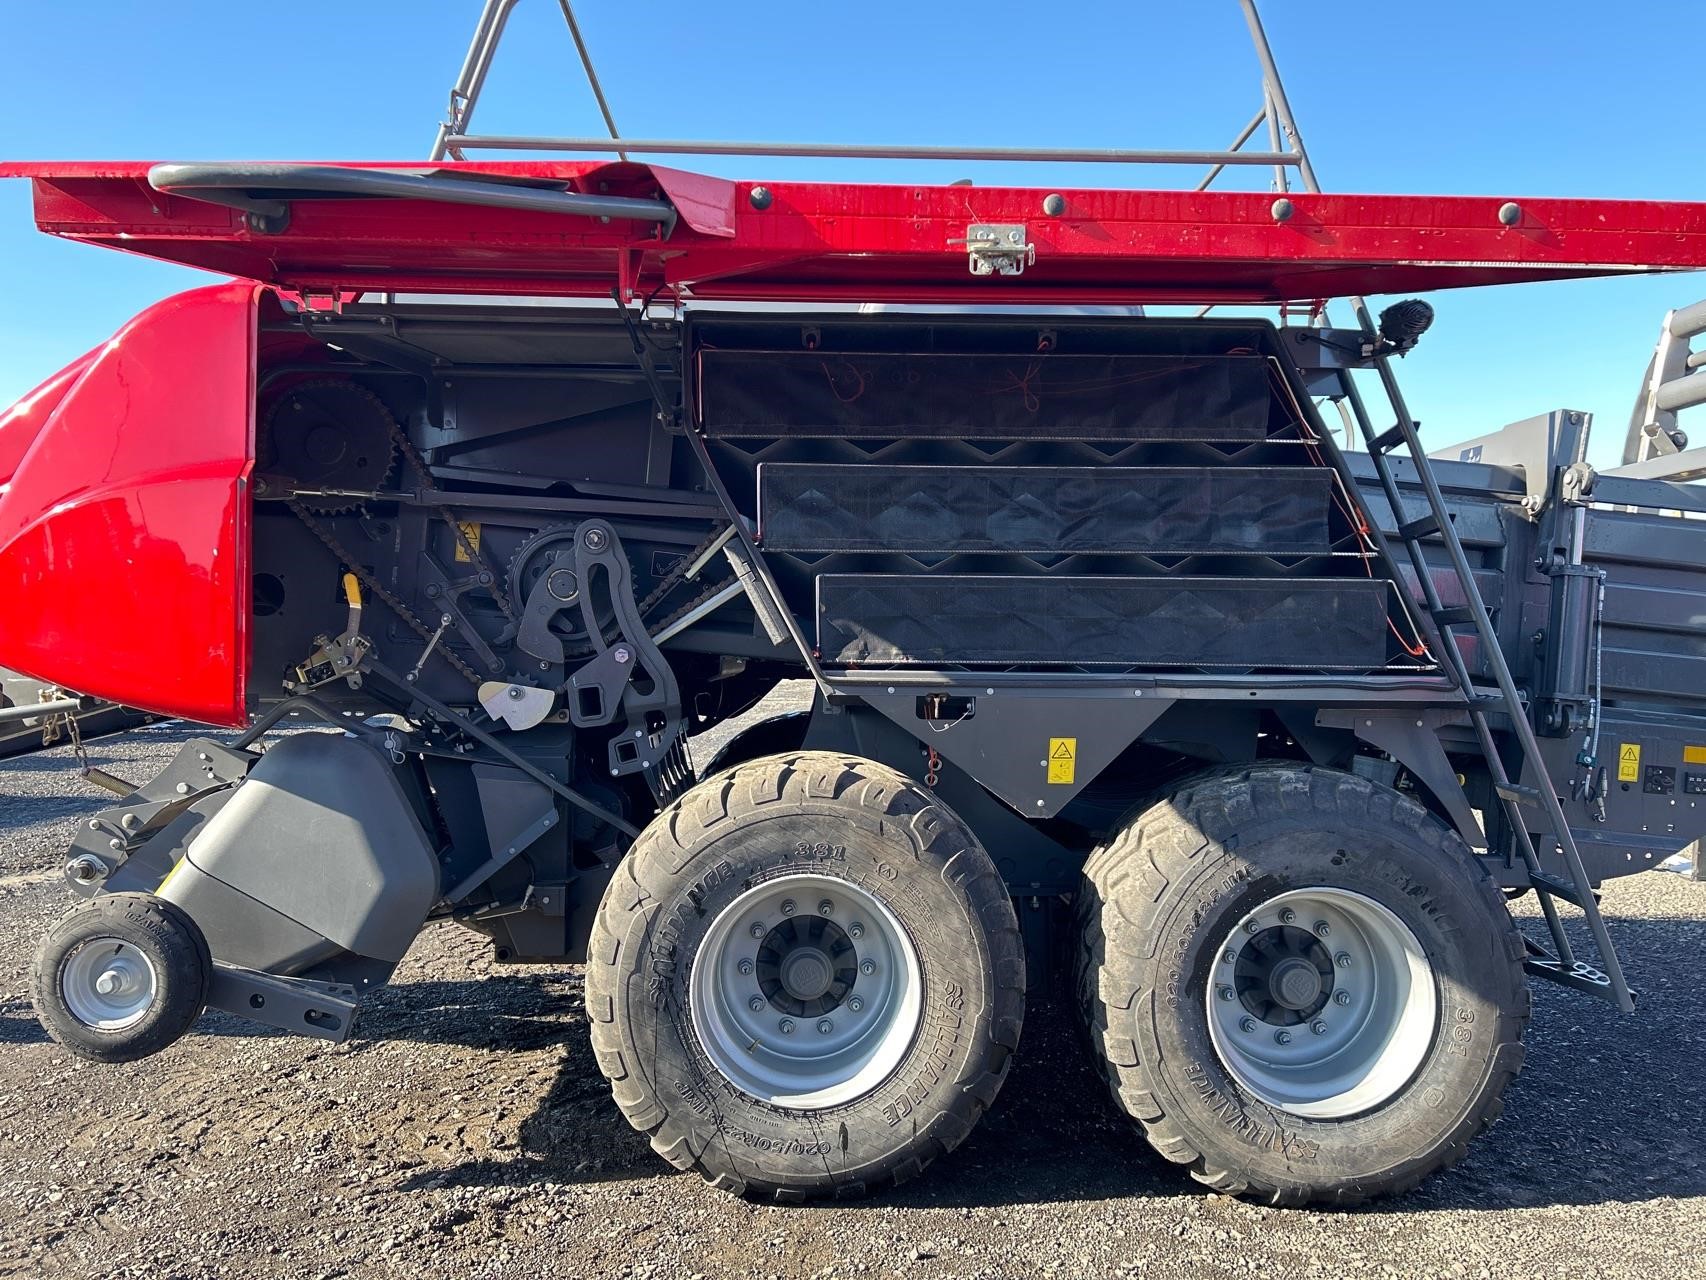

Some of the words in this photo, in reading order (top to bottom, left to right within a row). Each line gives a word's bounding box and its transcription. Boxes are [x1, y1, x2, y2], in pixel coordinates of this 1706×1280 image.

[795, 841, 847, 862] 381
[652, 859, 735, 980] ALLIANCE
[882, 1002, 962, 1128] ALLIANCE
[1447, 1007, 1475, 1057] 381
[673, 1079, 708, 1115] IMP
[1183, 1061, 1291, 1153] ALLIANCE
